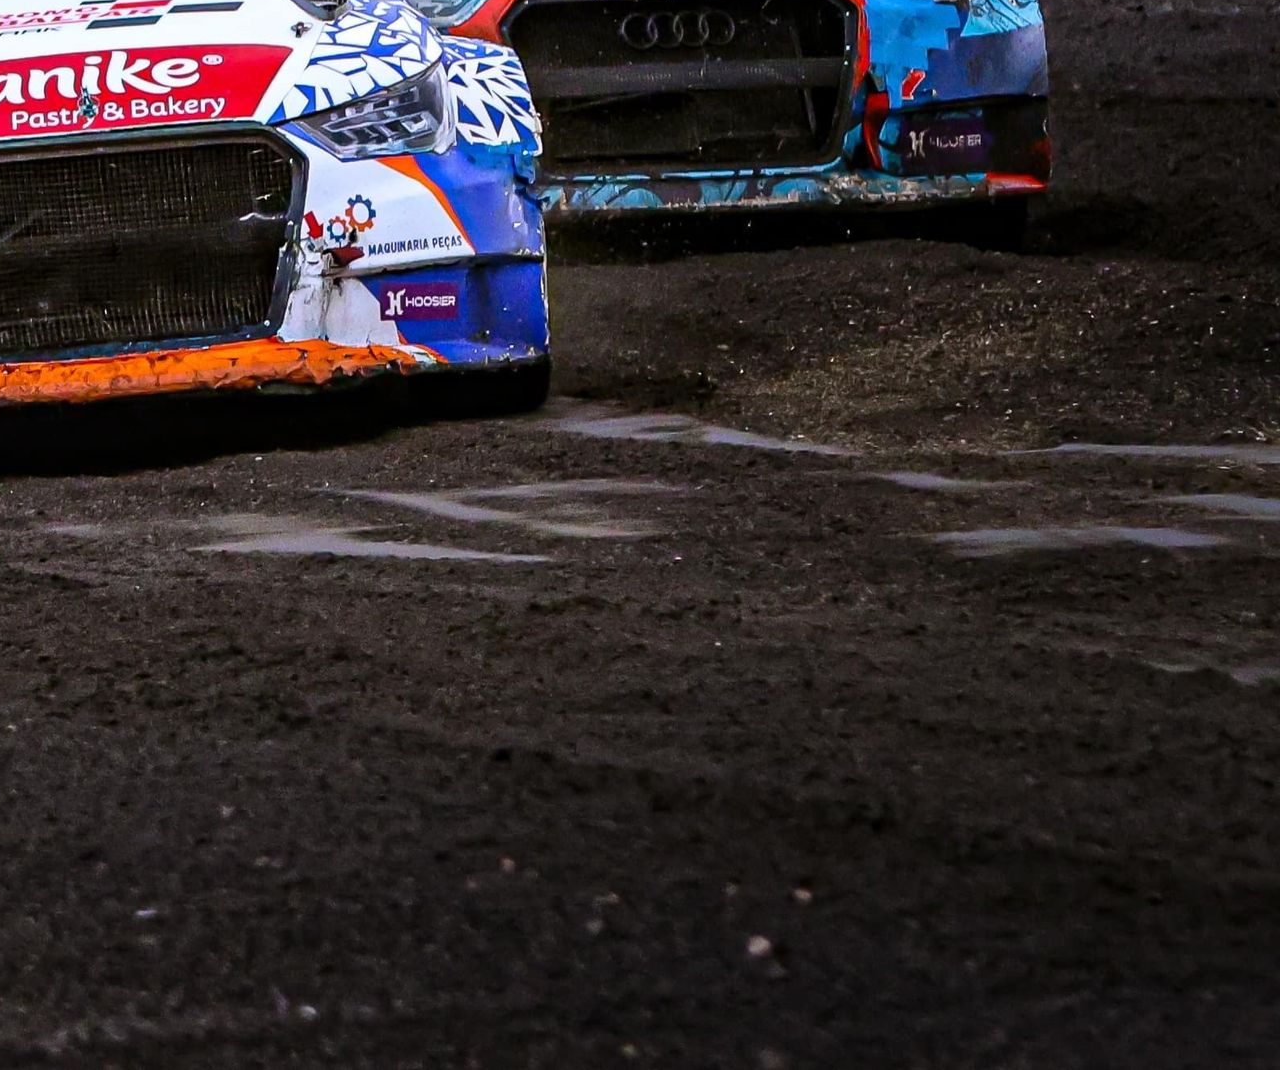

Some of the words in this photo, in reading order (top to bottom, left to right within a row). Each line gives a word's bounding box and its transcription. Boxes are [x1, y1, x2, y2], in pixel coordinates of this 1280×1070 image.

[102, 101, 127, 121] &
[131, 95, 226, 121] Bakery
[368, 240, 430, 256] MAQUINARIA
[432, 234, 463, 251] PEÇAS
[405, 294, 456, 307] HOOSIER
